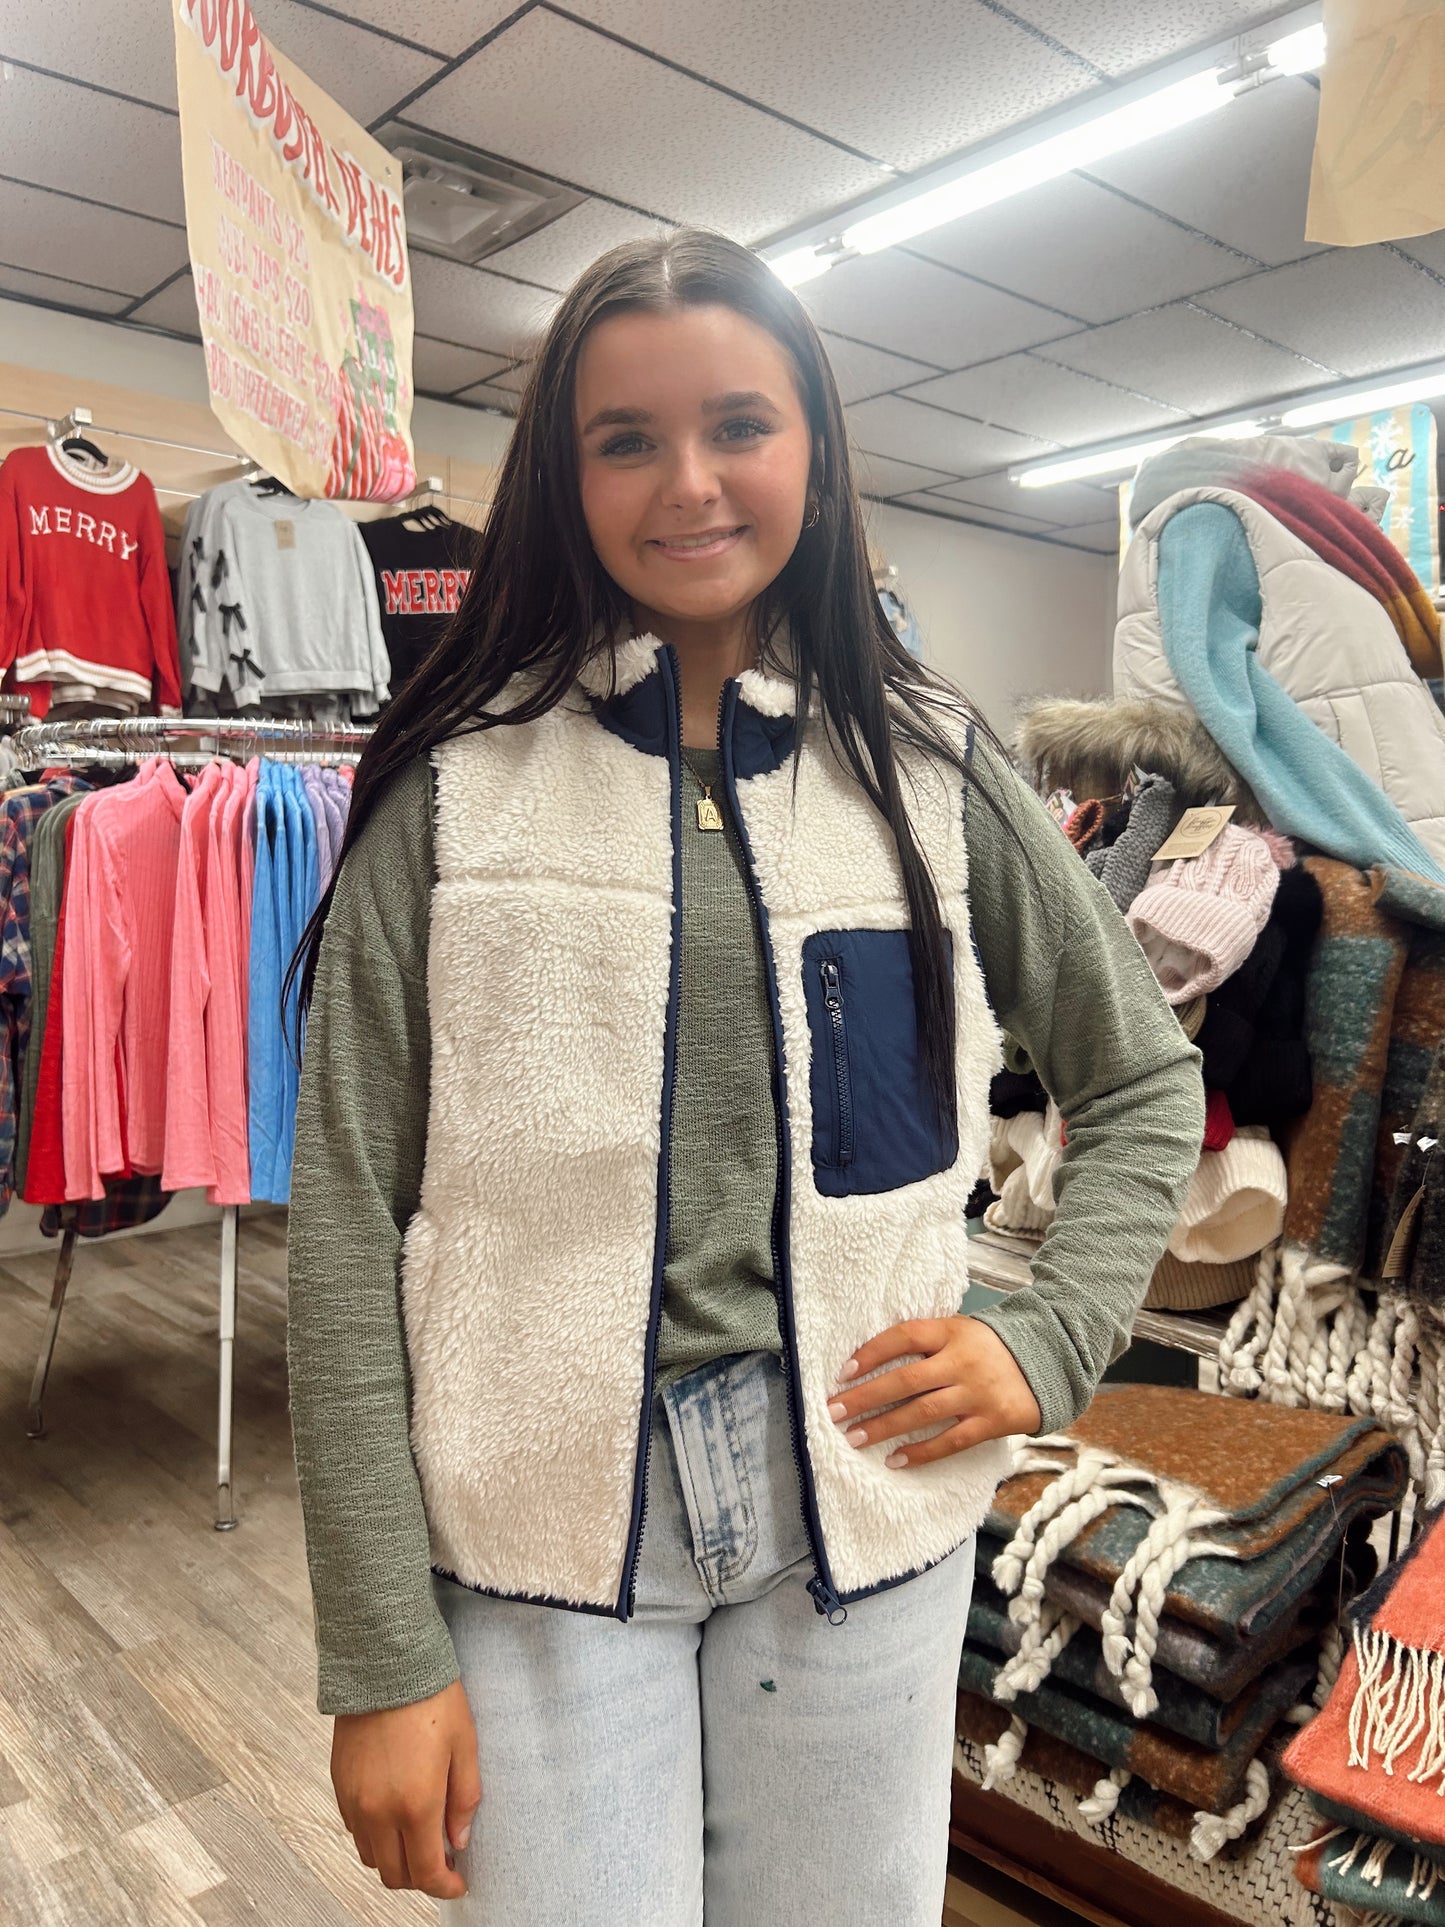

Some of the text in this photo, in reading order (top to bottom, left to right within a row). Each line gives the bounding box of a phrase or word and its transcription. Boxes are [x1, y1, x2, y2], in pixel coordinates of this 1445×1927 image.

[188, 0, 405, 286] OORBUSTER DEALS
[284, 275, 311, 327] $20
[264, 315, 308, 387] SLEEVE
[29, 505, 139, 561] MERRY
